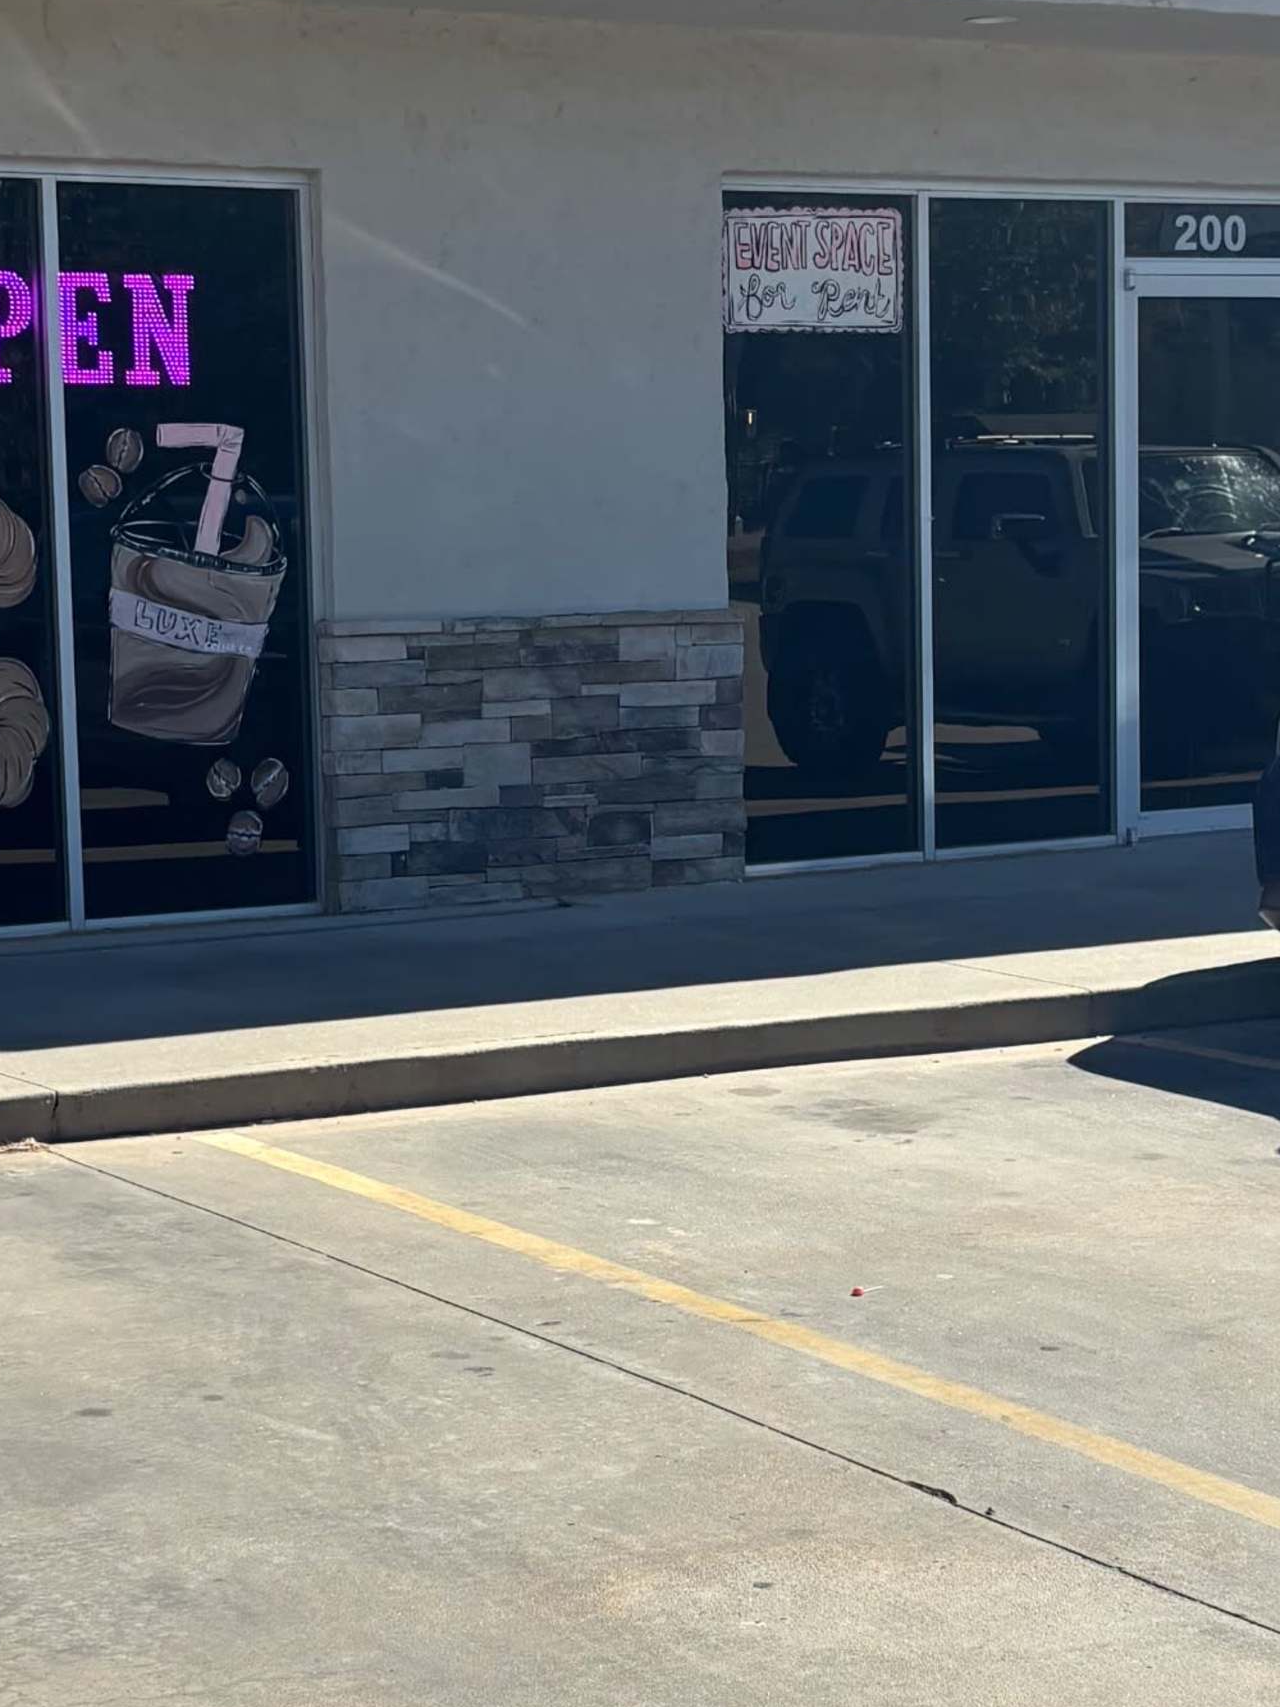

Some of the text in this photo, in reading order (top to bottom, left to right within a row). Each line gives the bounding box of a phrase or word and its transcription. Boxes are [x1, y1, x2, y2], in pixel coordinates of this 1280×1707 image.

[733, 220, 893, 276] EVENT SPACE
[1174, 214, 1246, 252] 200
[737, 273, 891, 322] for Rent
[134, 599, 222, 647] LUXE
